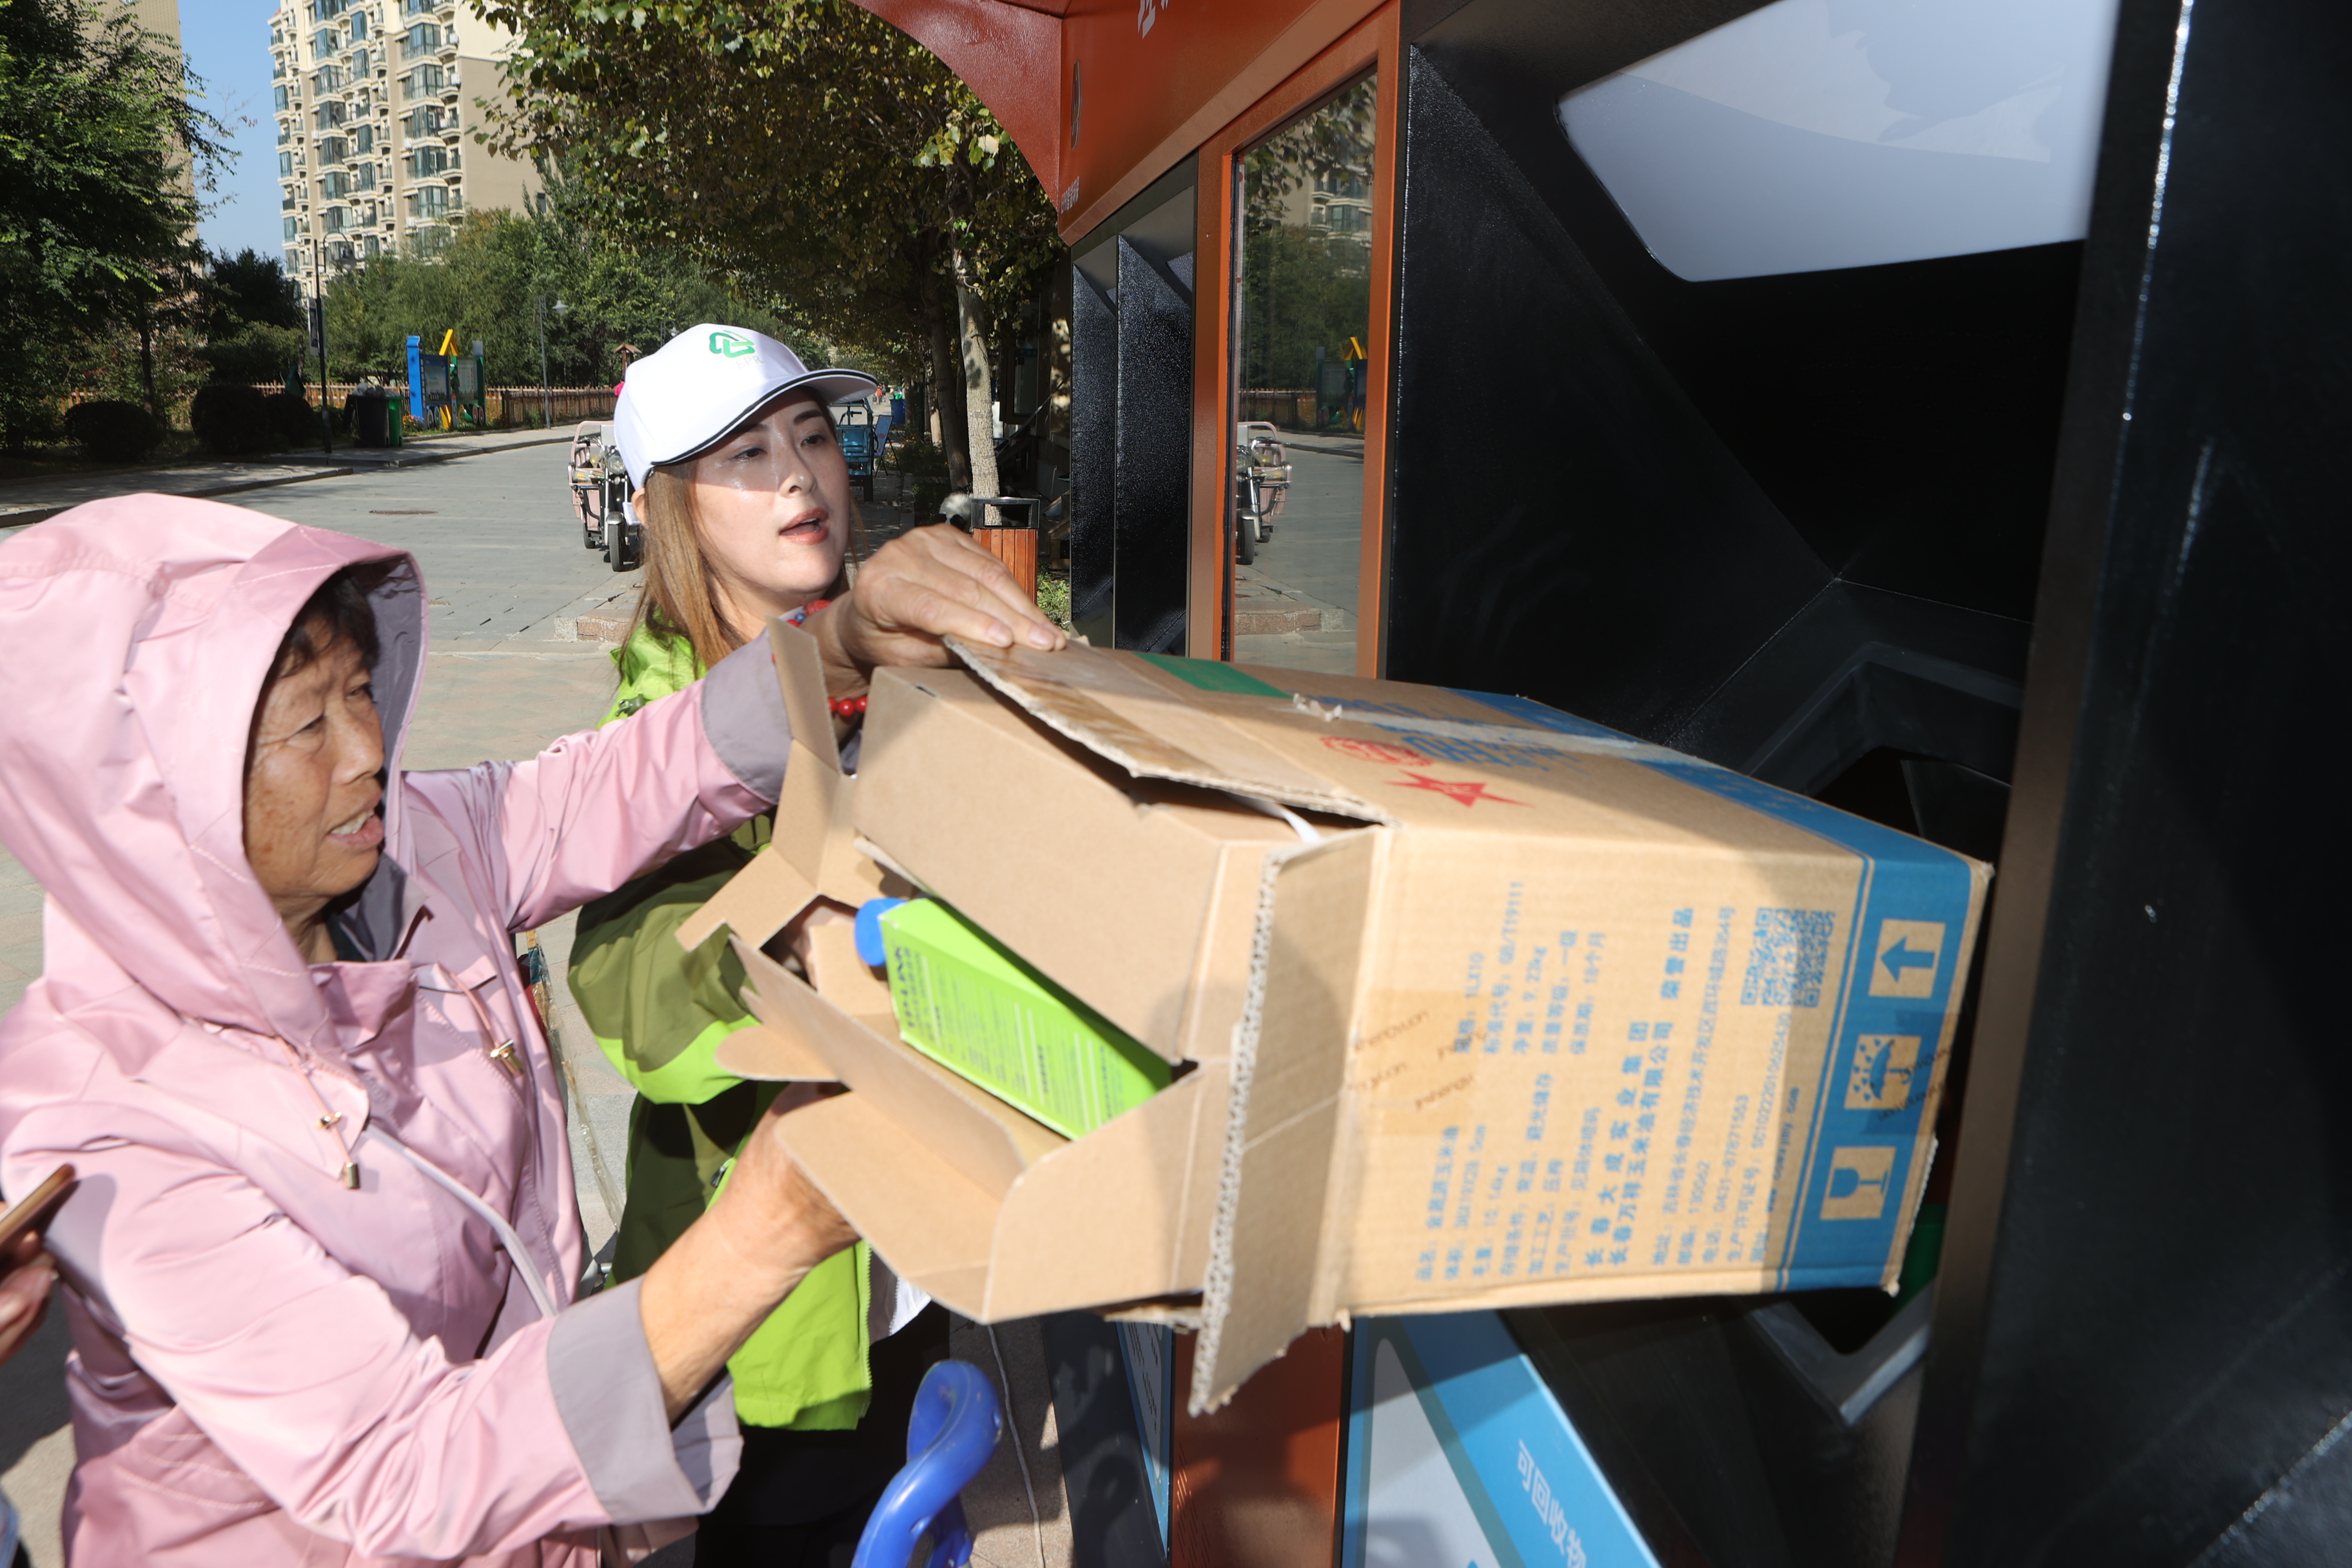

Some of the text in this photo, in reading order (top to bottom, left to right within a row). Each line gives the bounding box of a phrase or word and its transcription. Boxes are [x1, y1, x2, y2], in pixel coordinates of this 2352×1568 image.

[736, 356, 765, 369] EPR
[1609, 908, 1693, 1265] 长春万祥玉米油有限公司 荣誉出品
[1517, 1438, 1587, 1568] 可回收物
